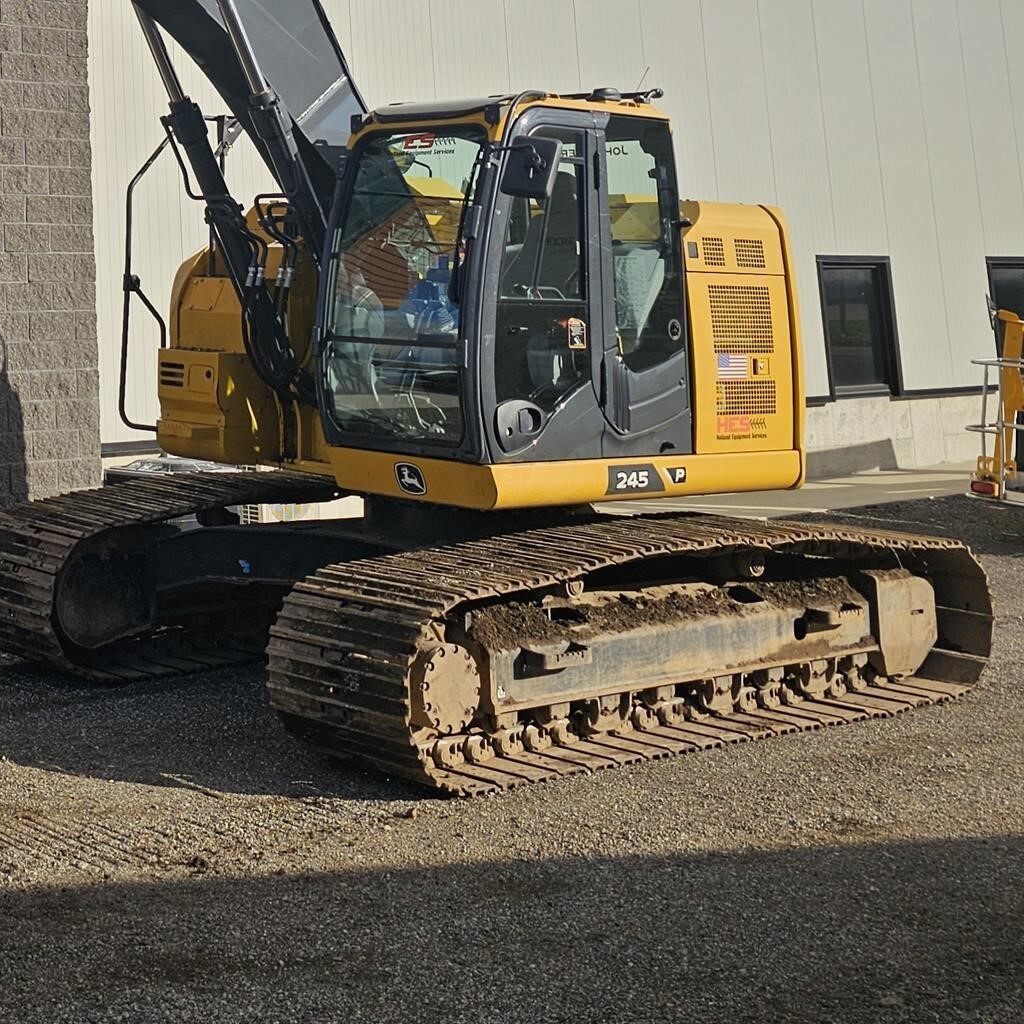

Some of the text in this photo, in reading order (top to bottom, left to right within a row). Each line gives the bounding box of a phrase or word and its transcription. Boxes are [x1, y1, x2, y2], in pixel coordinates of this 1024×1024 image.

[717, 416, 750, 433] HES
[616, 468, 685, 489] 245 P
